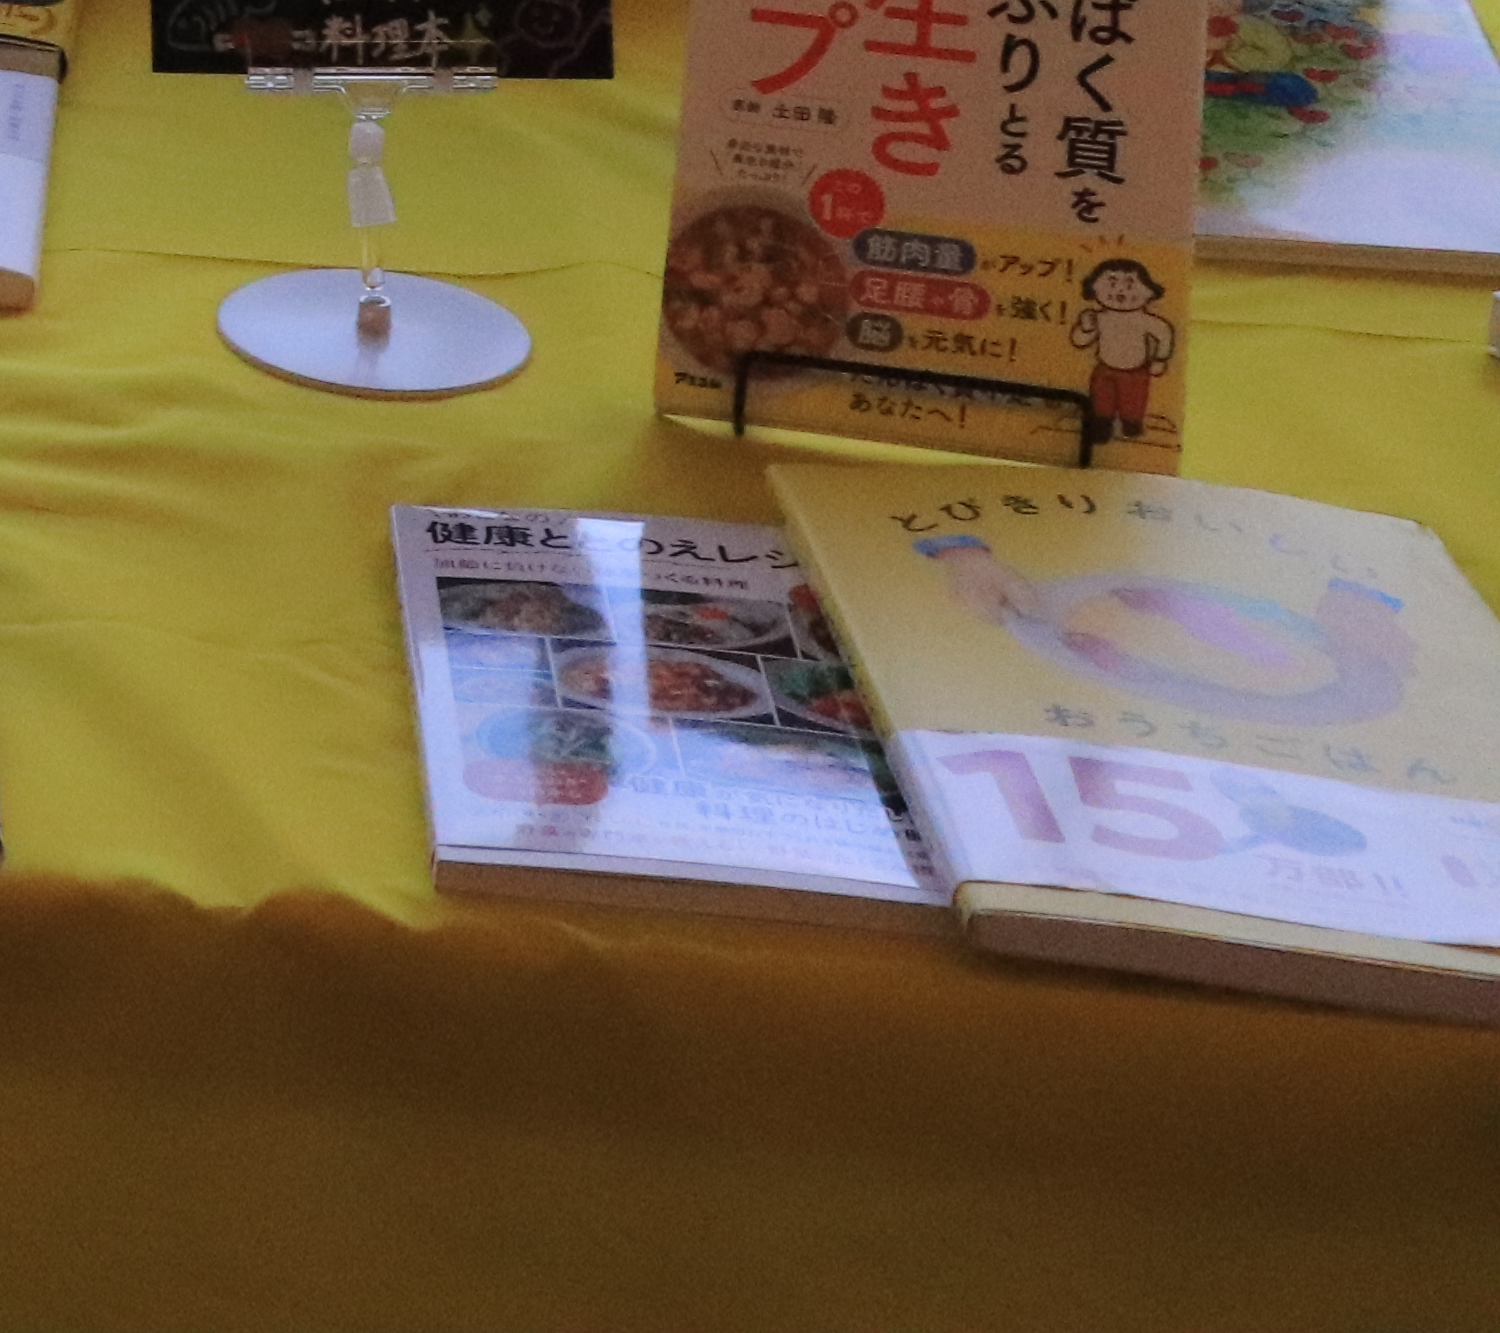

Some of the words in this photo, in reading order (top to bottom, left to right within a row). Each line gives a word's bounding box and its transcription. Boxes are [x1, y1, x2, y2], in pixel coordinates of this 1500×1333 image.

[1042, 702, 1460, 787] おうちごはん
[935, 747, 1228, 863] 15
